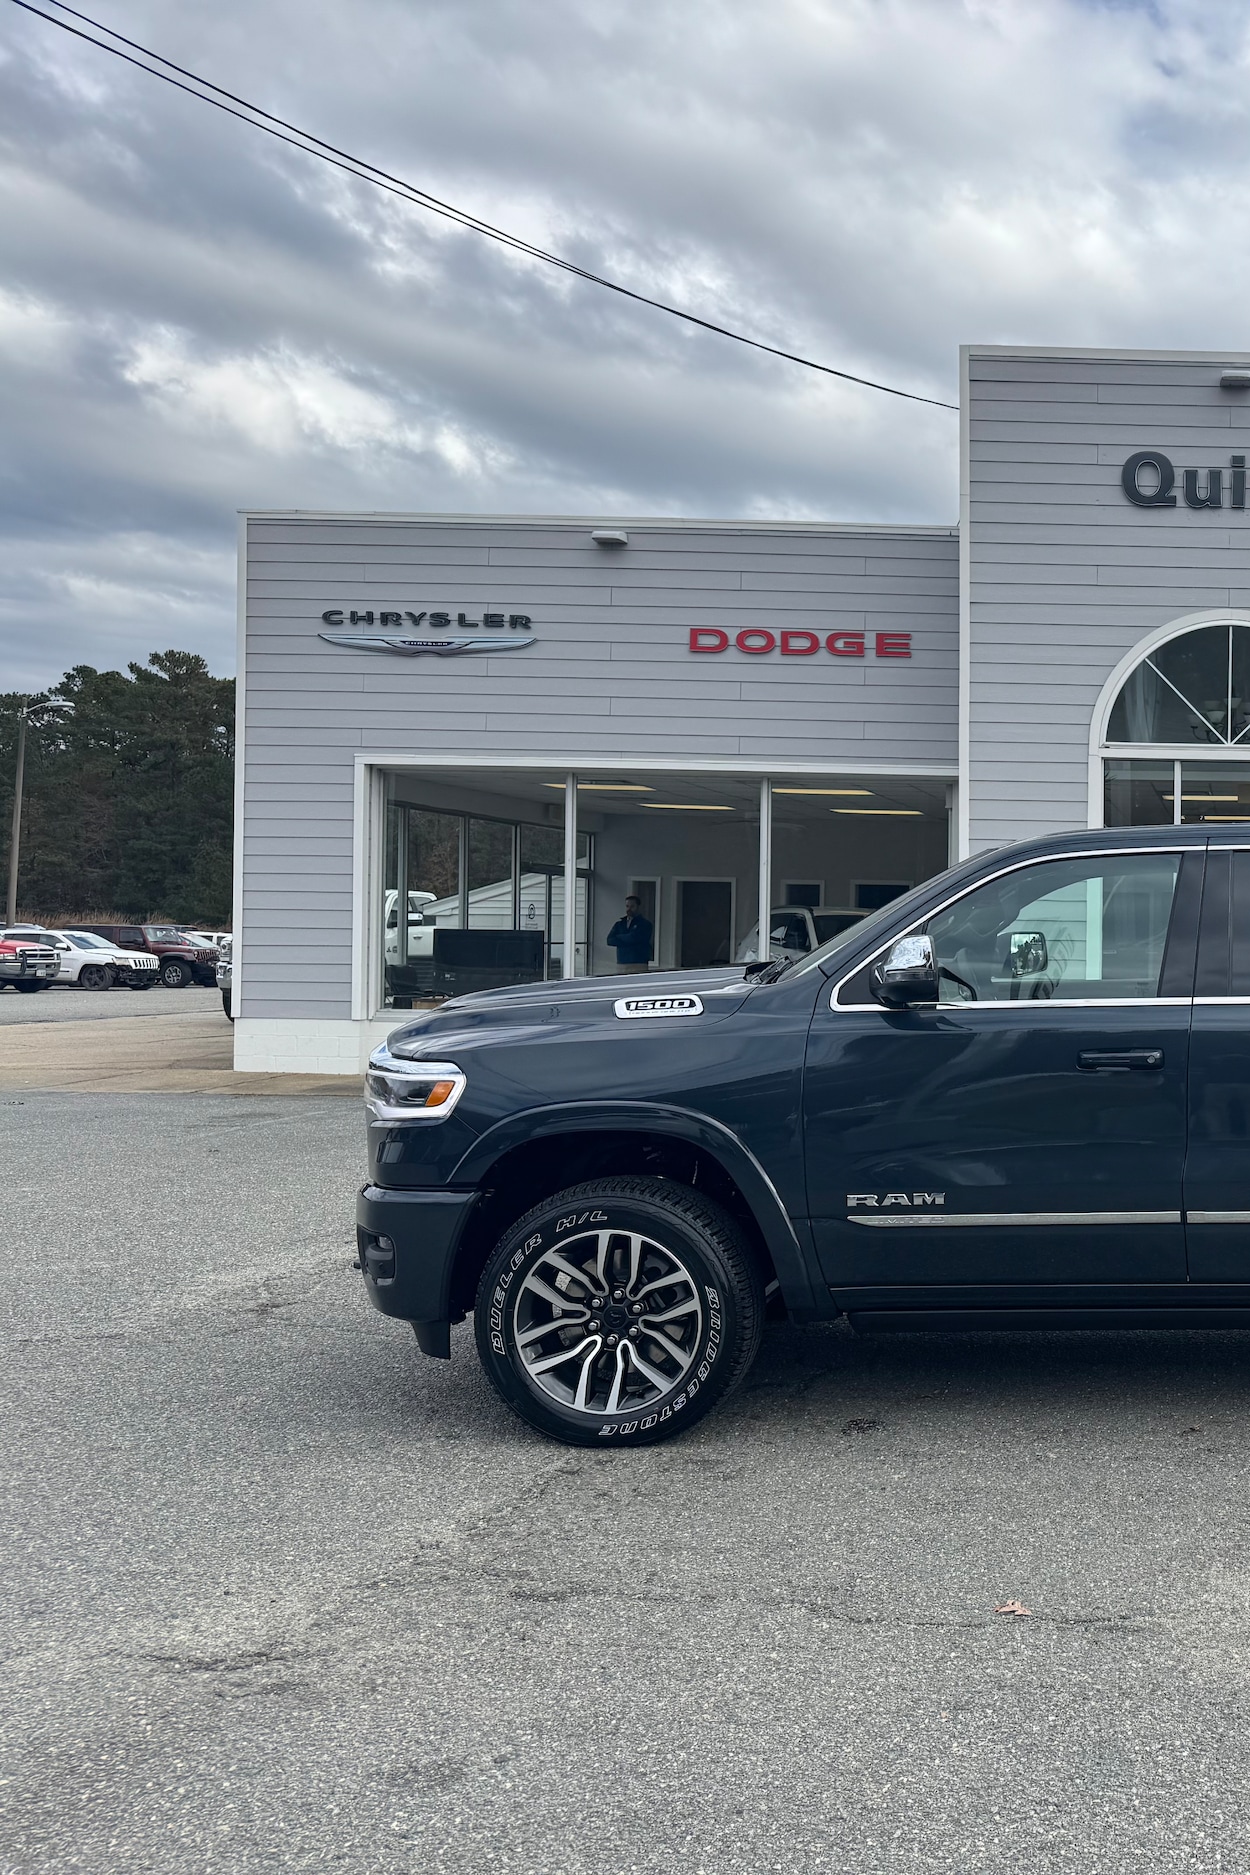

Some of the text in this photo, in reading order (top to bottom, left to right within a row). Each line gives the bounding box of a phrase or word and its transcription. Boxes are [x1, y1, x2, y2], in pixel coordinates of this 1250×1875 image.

[321, 609, 532, 630] CHRYSLER
[689, 627, 913, 658] DODGE
[628, 999, 692, 1011] 1500
[846, 1192, 946, 1207] RAM
[489, 1210, 608, 1355] DUELER H/L
[598, 1285, 721, 1436] BRIDGESTONE
